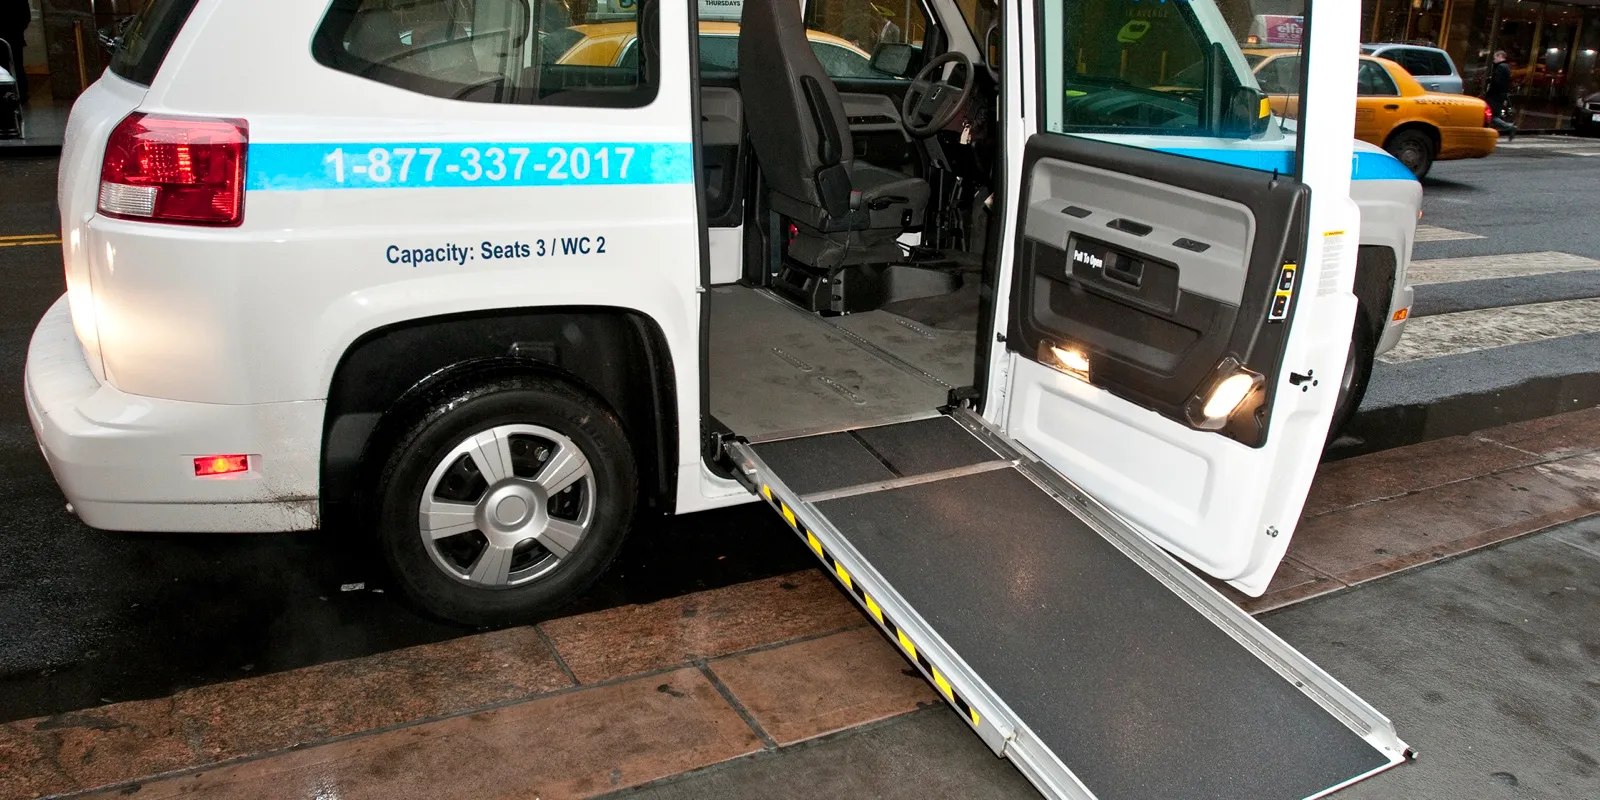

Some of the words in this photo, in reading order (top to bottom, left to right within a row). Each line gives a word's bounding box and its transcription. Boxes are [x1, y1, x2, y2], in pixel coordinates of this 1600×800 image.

[326, 147, 635, 183] 1-877-337-2017
[386, 243, 474, 267] Capacity:
[481, 241, 531, 260] Seats
[536, 239, 546, 257] 3
[551, 238, 557, 256] /
[561, 237, 591, 255] WC
[596, 236, 606, 254] 2
[1073, 249, 1083, 262] Pull
[1083, 252, 1090, 264] To
[1089, 254, 1103, 269] Open
